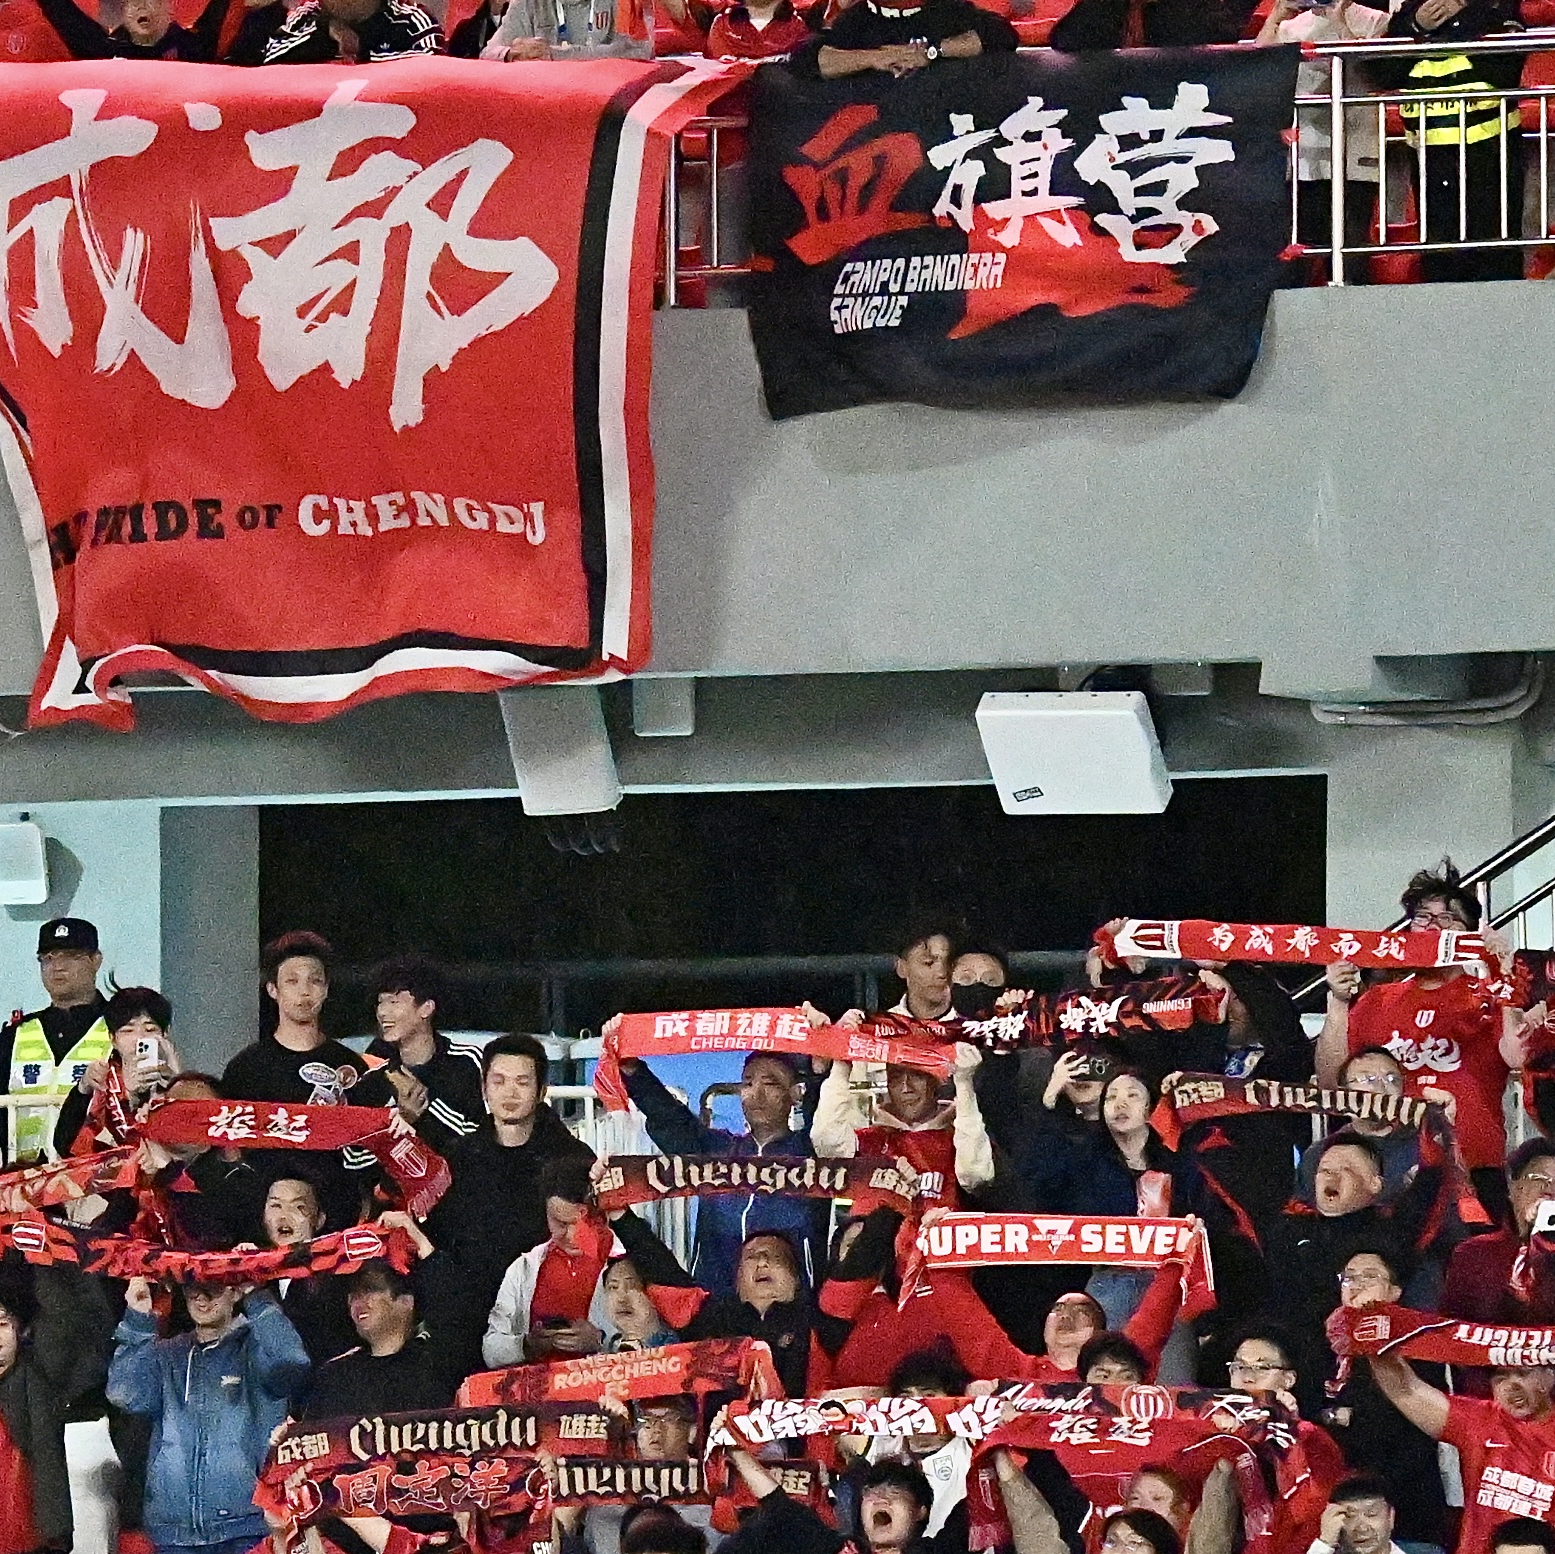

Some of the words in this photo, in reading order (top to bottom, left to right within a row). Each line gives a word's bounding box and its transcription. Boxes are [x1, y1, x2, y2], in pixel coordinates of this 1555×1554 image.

[782, 81, 1235, 266] 血旗营
[833, 260, 904, 296] CAMPO
[903, 251, 1007, 293] BANDIERA
[830, 296, 909, 335] SANGUE
[1208, 921, 1405, 961] 为成都而战
[655, 1008, 810, 1040] 成都雄起
[645, 1157, 847, 1195] Chengdu
[348, 1408, 538, 1460] Chengdu
